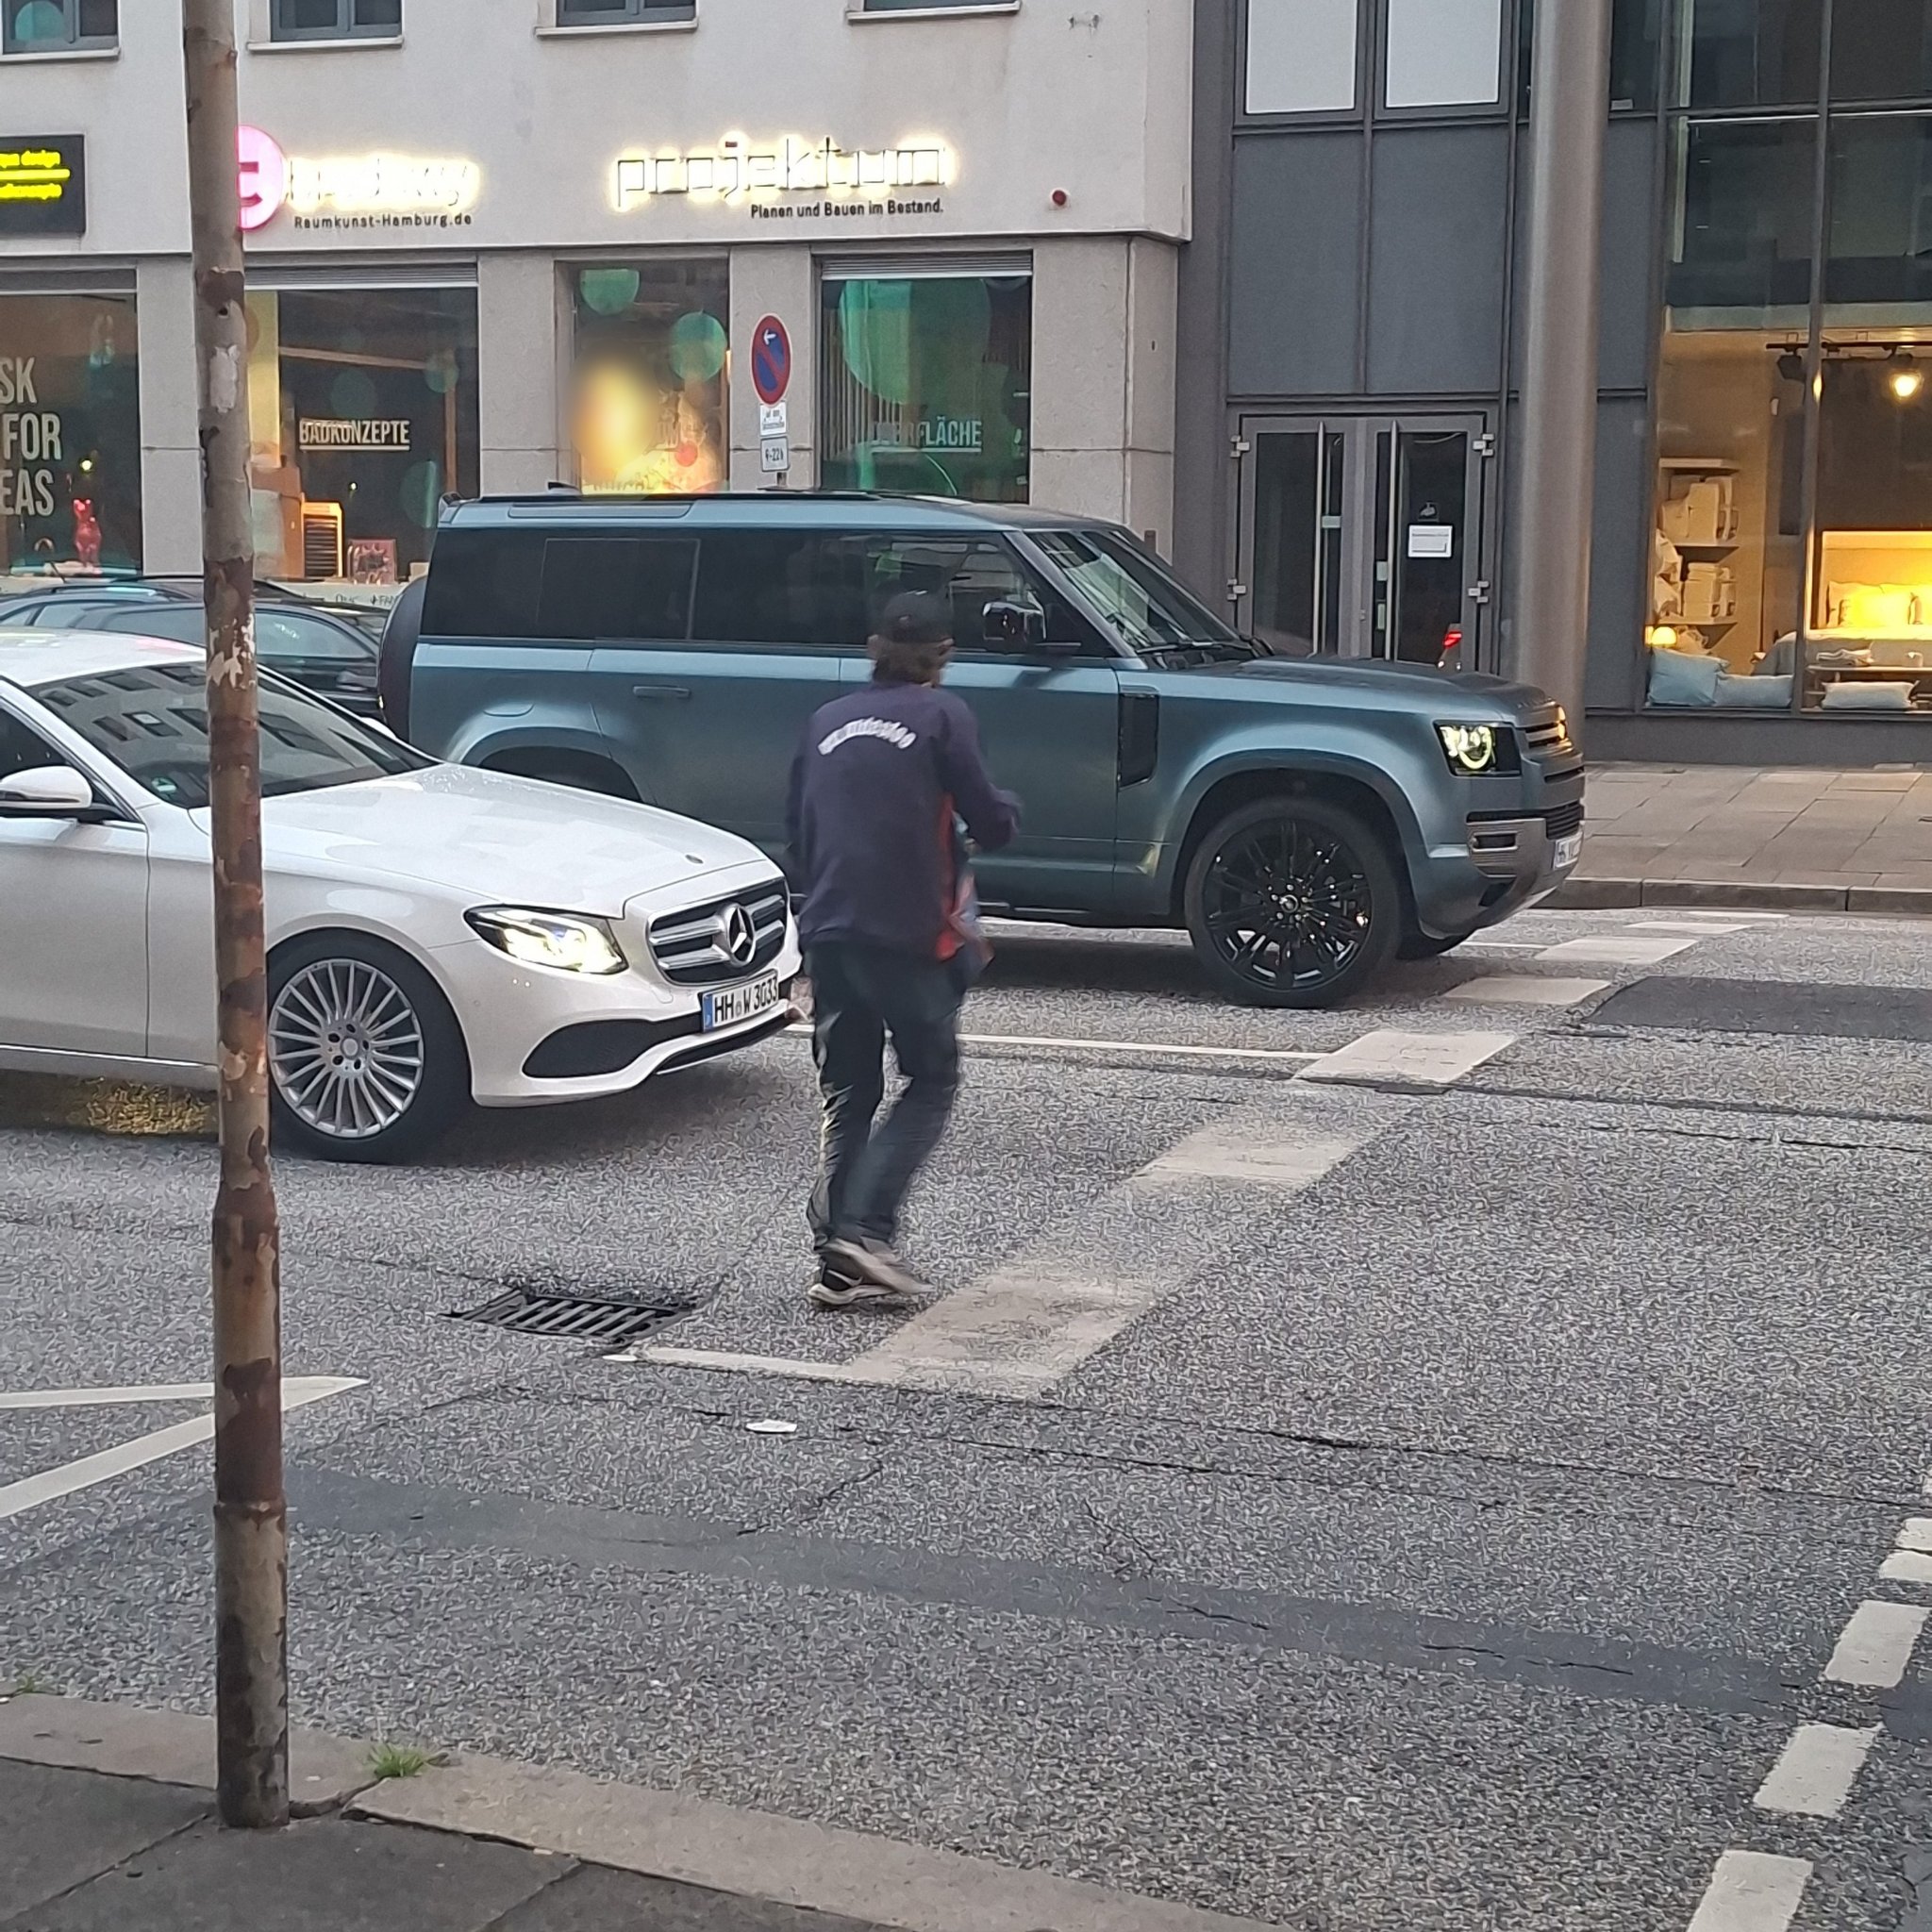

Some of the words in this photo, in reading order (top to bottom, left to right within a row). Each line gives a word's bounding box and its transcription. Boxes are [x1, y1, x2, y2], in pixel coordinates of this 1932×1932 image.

[751, 203, 793, 219] Planen
[796, 202, 821, 217] und
[824, 201, 865, 216] Bauen
[868, 200, 884, 215] im
[888, 197, 944, 214] Bestand.
[293, 212, 473, 229] Raumkunst-Hamburg.de
[3, 412, 62, 460] FOR
[299, 419, 410, 443] BADKONZEPTE
[714, 992, 734, 1023] HH
